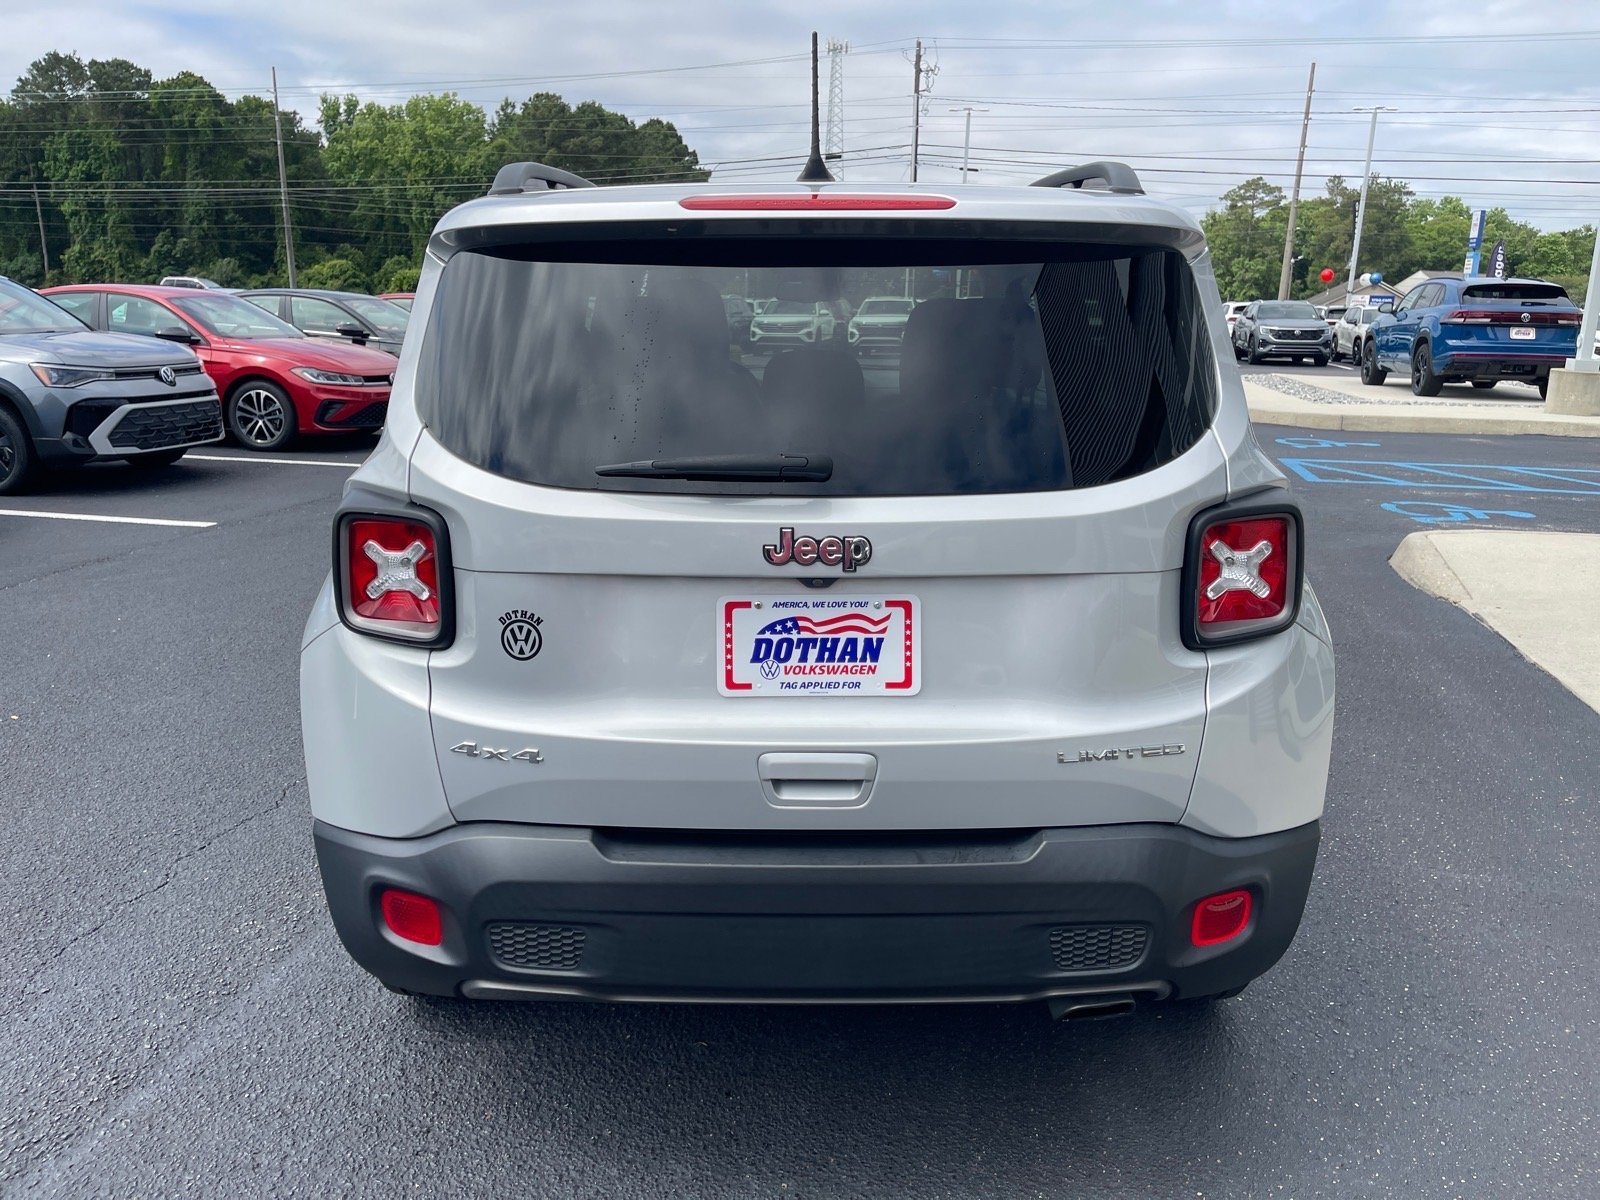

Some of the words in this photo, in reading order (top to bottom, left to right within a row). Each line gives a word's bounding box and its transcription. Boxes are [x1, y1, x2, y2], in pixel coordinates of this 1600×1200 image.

[763, 527, 872, 573] Jeep
[772, 601, 810, 609] AMERICA,
[498, 609, 544, 627] DOTHAN
[750, 637, 885, 664] DOTHAN
[783, 665, 877, 676] VOLKSWAGEN
[780, 681, 798, 690] TAG
[799, 681, 840, 690] APPLIED
[841, 681, 861, 689] FOR
[1057, 743, 1186, 764] LIMITED
